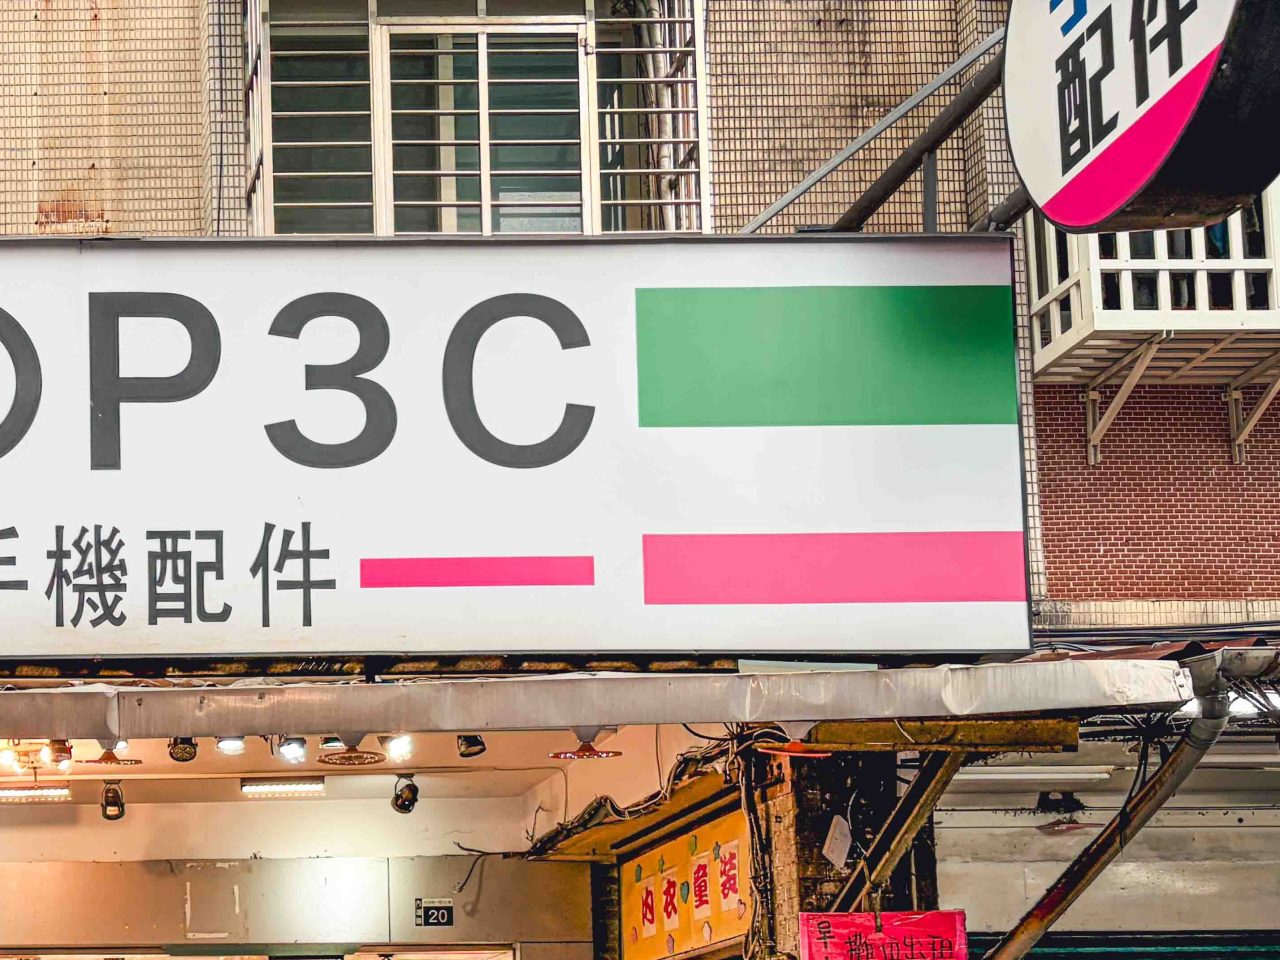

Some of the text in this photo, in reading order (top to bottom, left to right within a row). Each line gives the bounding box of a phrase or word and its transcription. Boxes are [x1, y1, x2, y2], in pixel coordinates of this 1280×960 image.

[1055, 0, 1198, 177] 配件
[428, 909, 448, 923] 20
[641, 851, 738, 927] 內衣童裝
